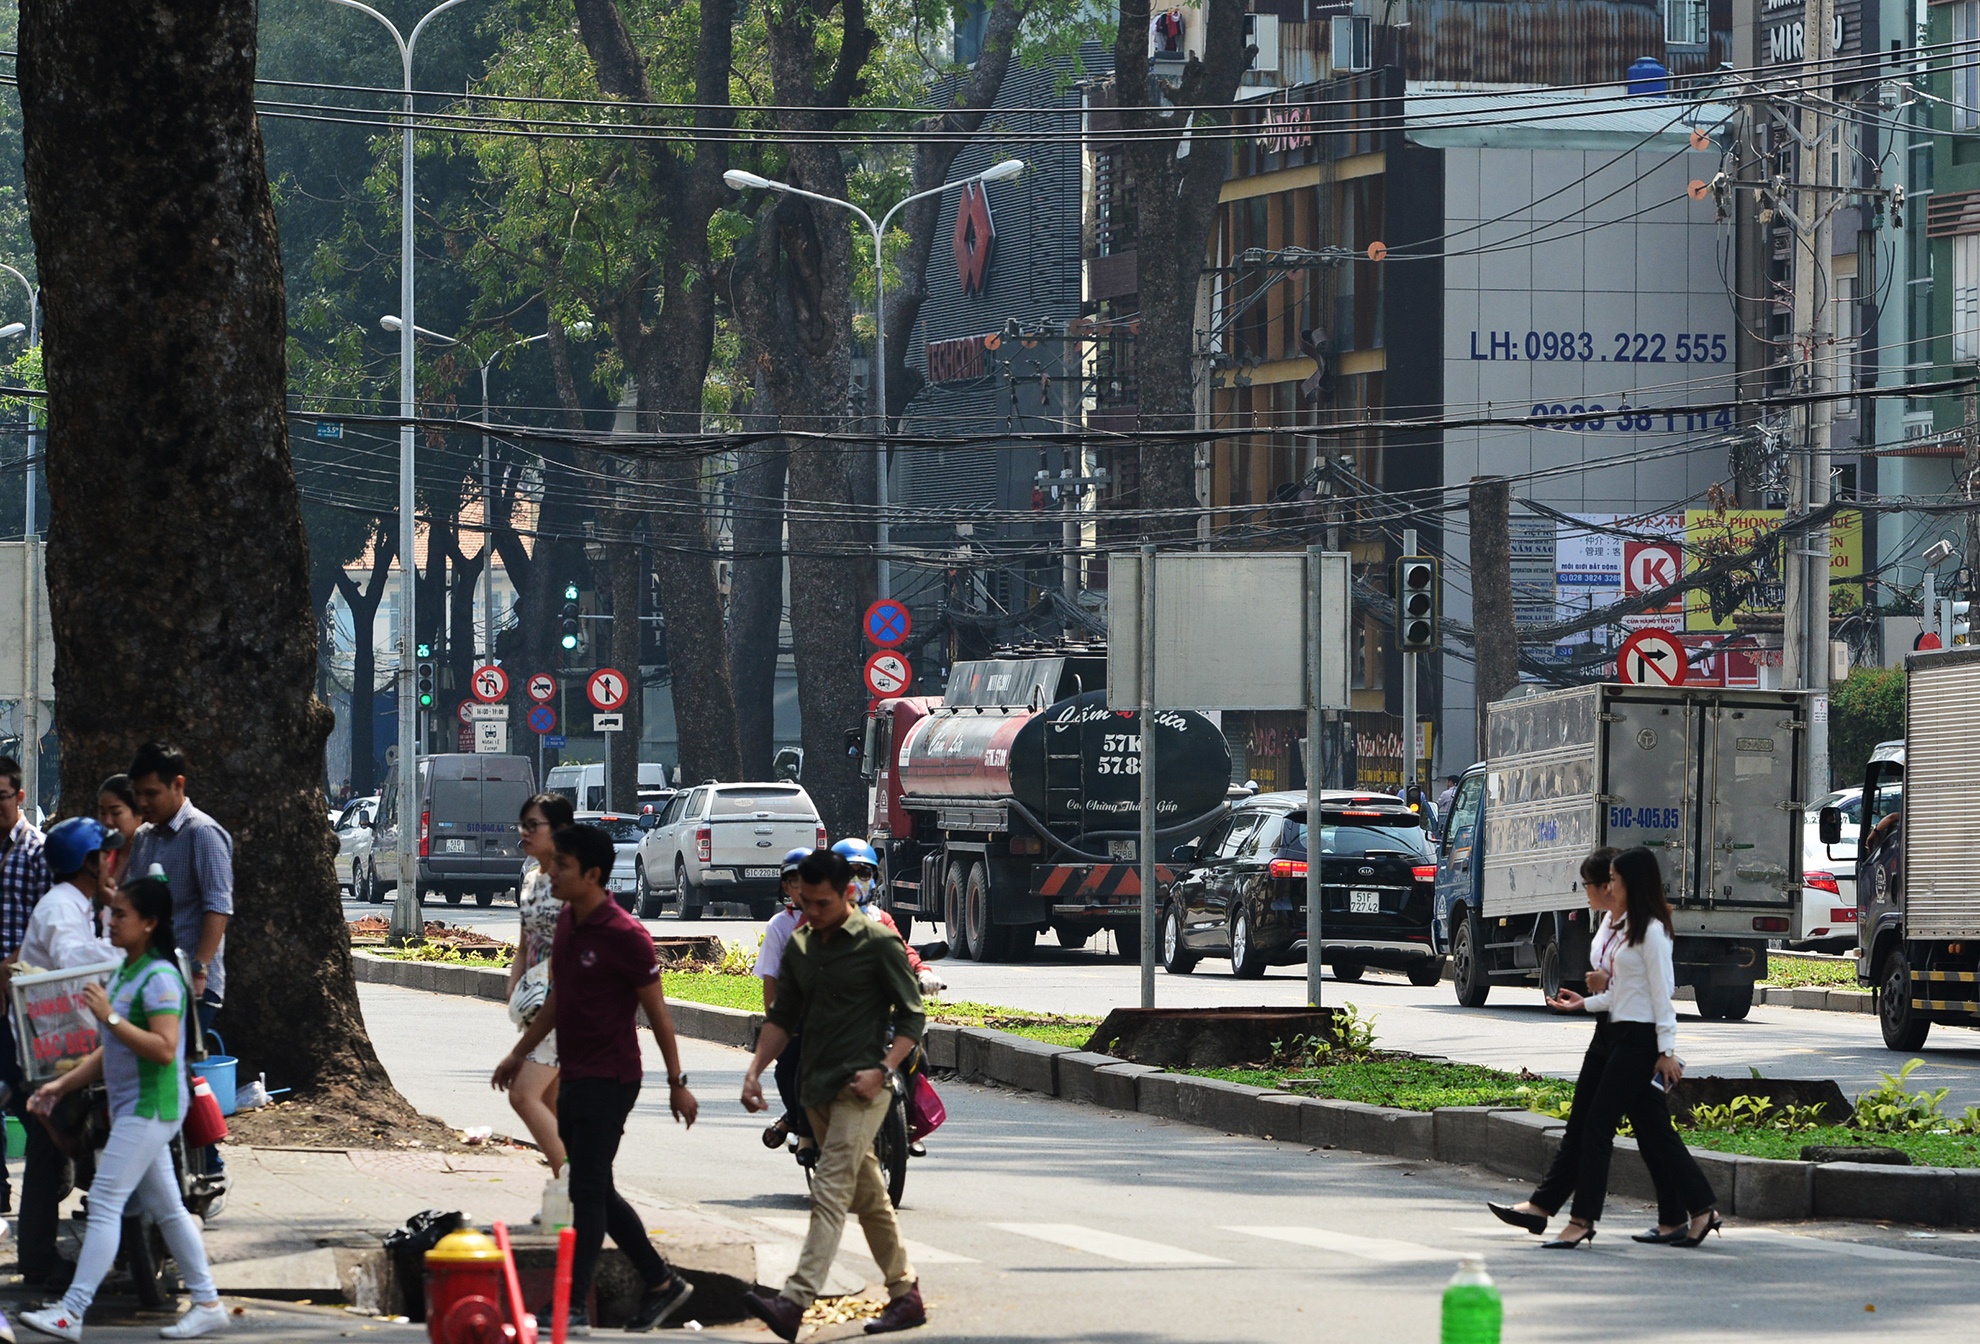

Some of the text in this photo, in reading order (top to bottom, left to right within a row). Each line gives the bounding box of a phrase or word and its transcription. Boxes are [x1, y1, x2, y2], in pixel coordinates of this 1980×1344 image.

[1470, 331, 1518, 360] LH:
[1525, 331, 1594, 361] 0983
[1614, 333, 1666, 363] 222
[1675, 334, 1727, 363] 555
[1643, 558, 1671, 589] K
[1097, 756, 1142, 775] 57.8
[1610, 806, 1679, 829] 51C-405.85
[1356, 892, 1372, 902] 51F
